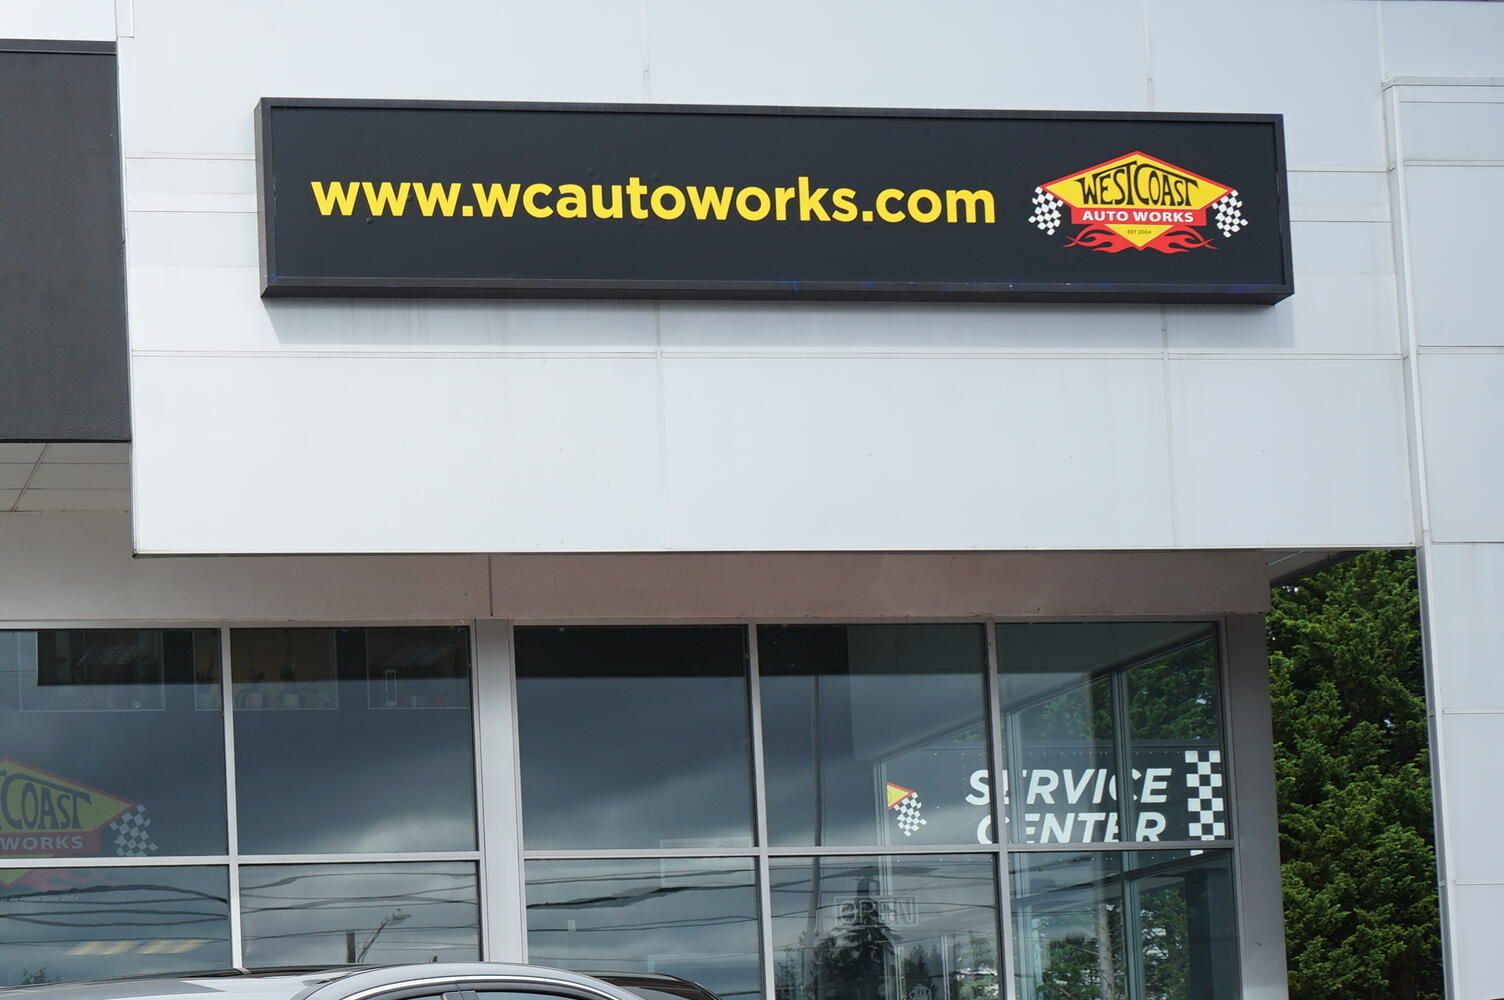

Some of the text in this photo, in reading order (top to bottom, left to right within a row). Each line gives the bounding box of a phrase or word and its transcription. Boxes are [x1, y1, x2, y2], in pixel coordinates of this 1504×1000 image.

[310, 176, 995, 223] www.wcautoworks.com
[1082, 210, 1194, 223] AUTO WORKS
[0, 836, 84, 851] WORKS
